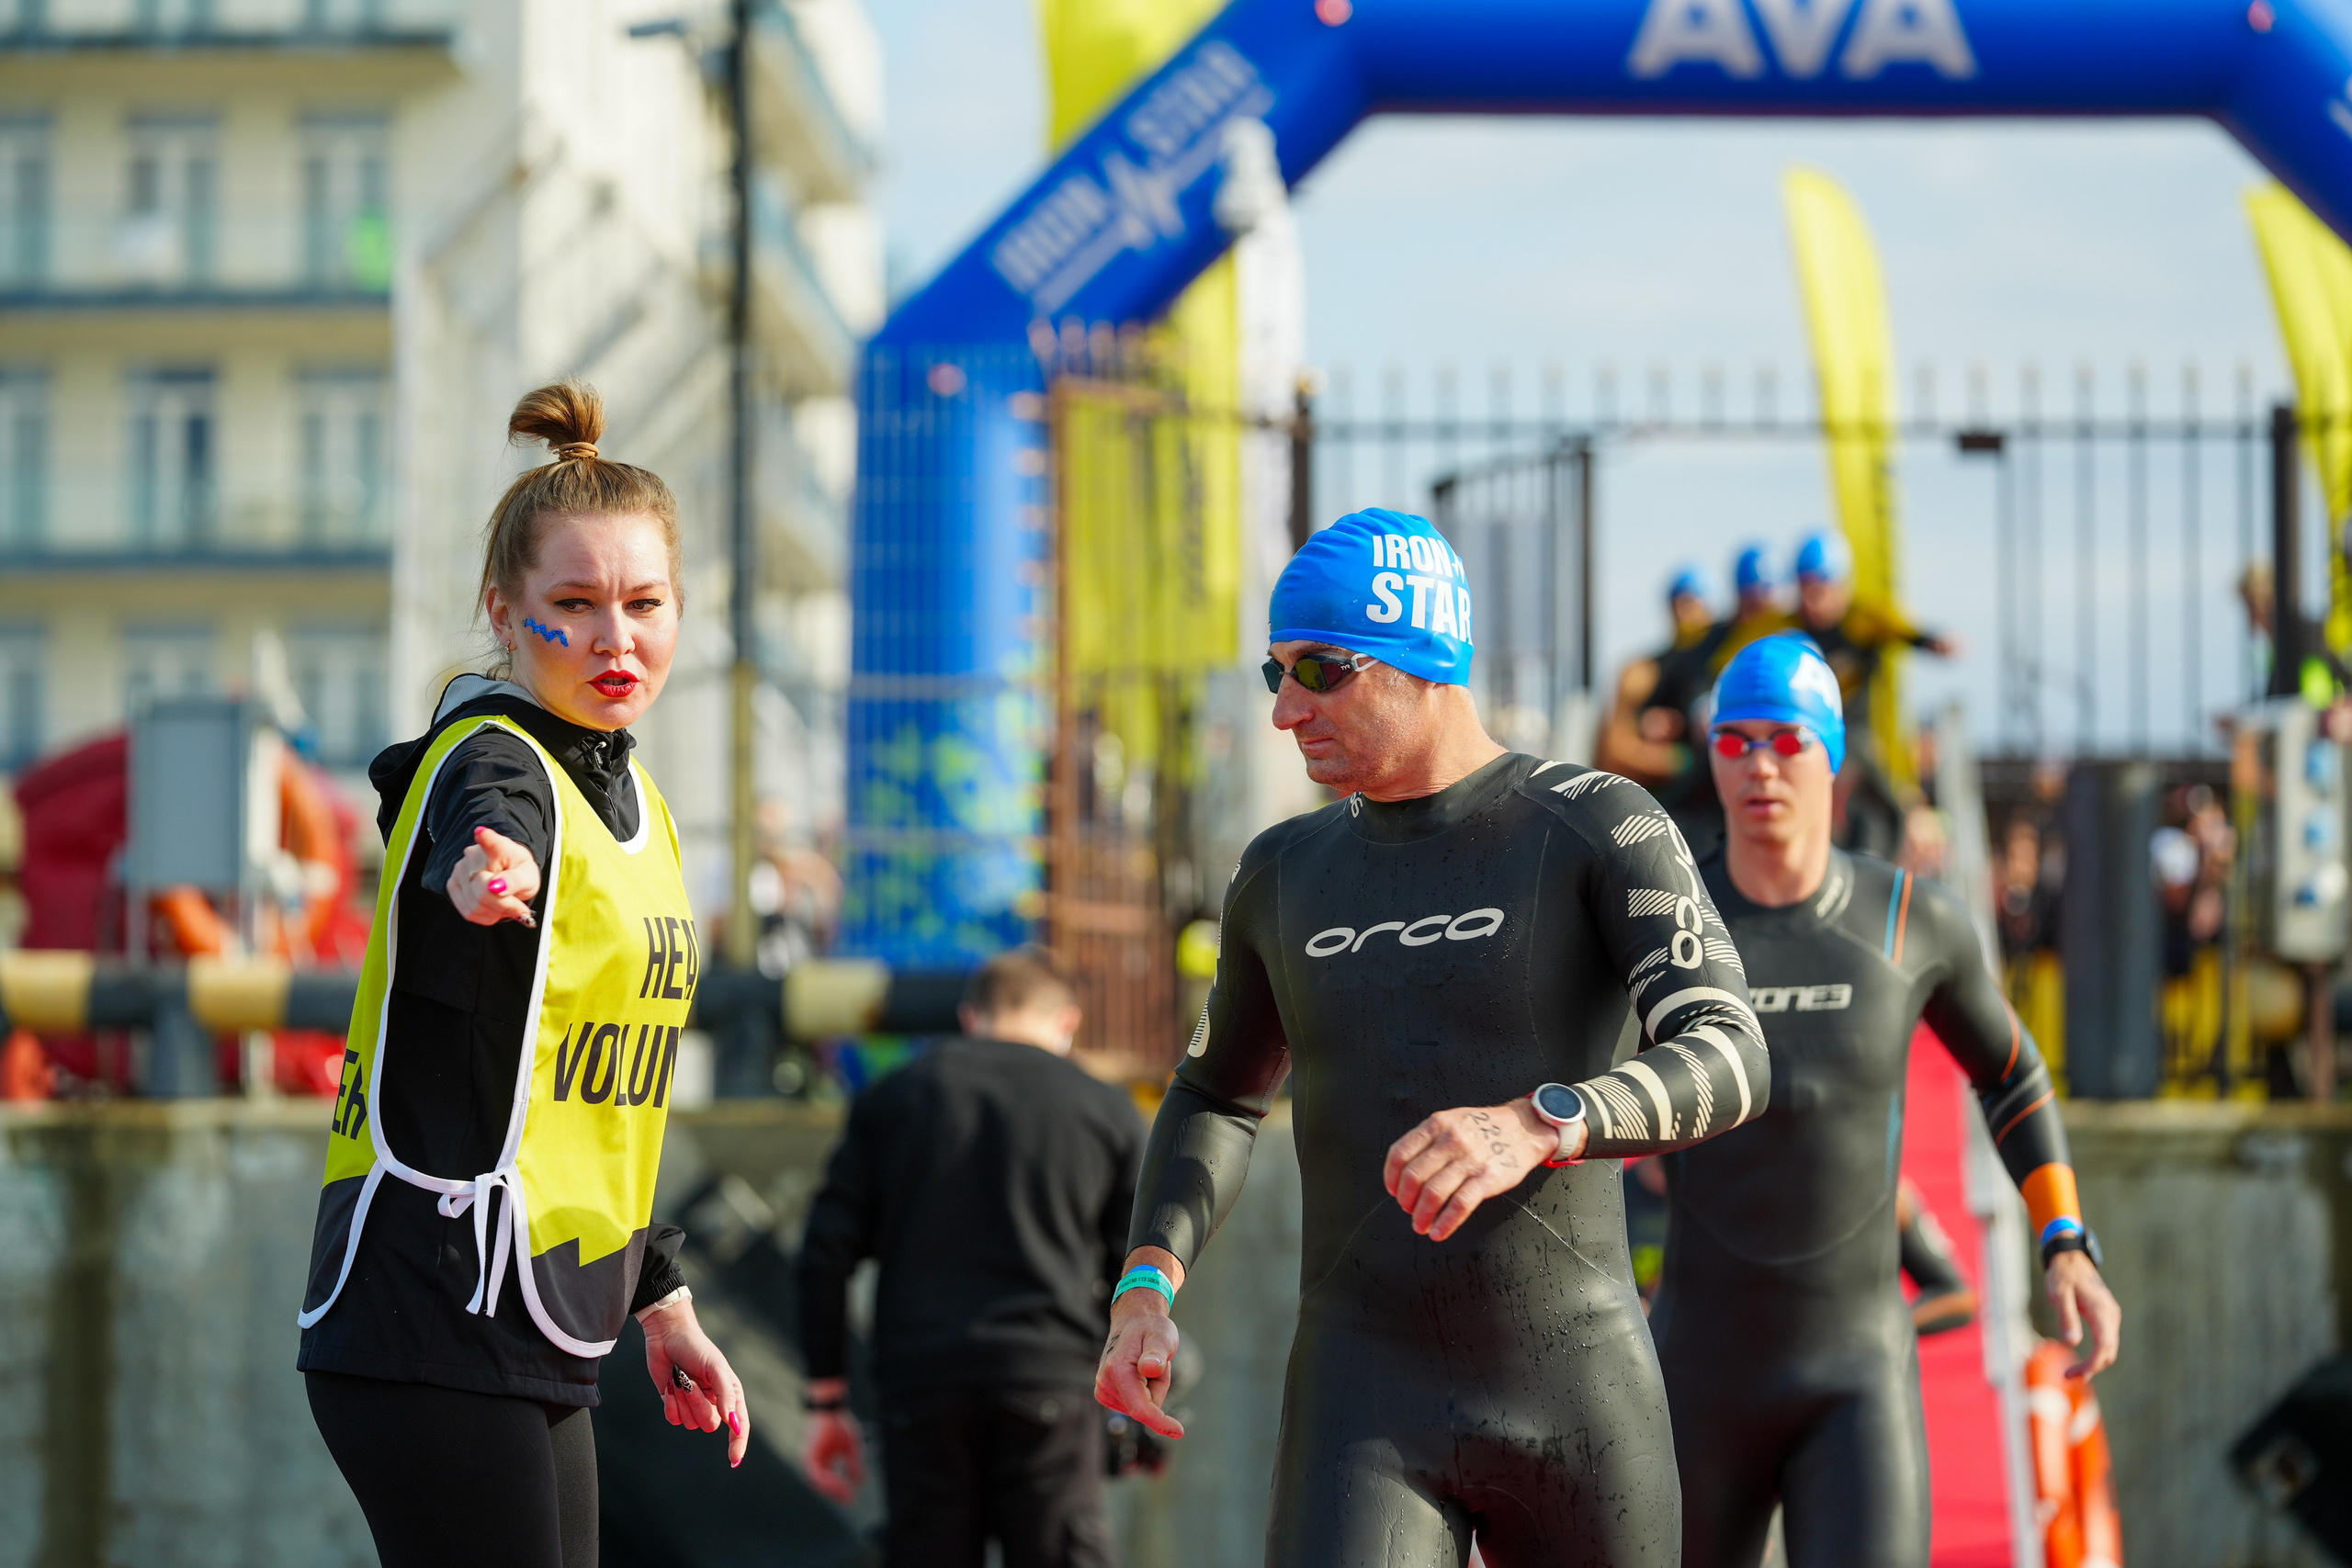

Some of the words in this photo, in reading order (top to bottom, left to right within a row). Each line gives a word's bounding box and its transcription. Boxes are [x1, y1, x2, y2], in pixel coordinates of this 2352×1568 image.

[1372, 534, 1453, 578] IRON
[1366, 571, 1474, 646] STAR
[639, 916, 700, 1000] HEA
[1305, 908, 1505, 958] orca
[553, 1021, 684, 1109] VOLUN
